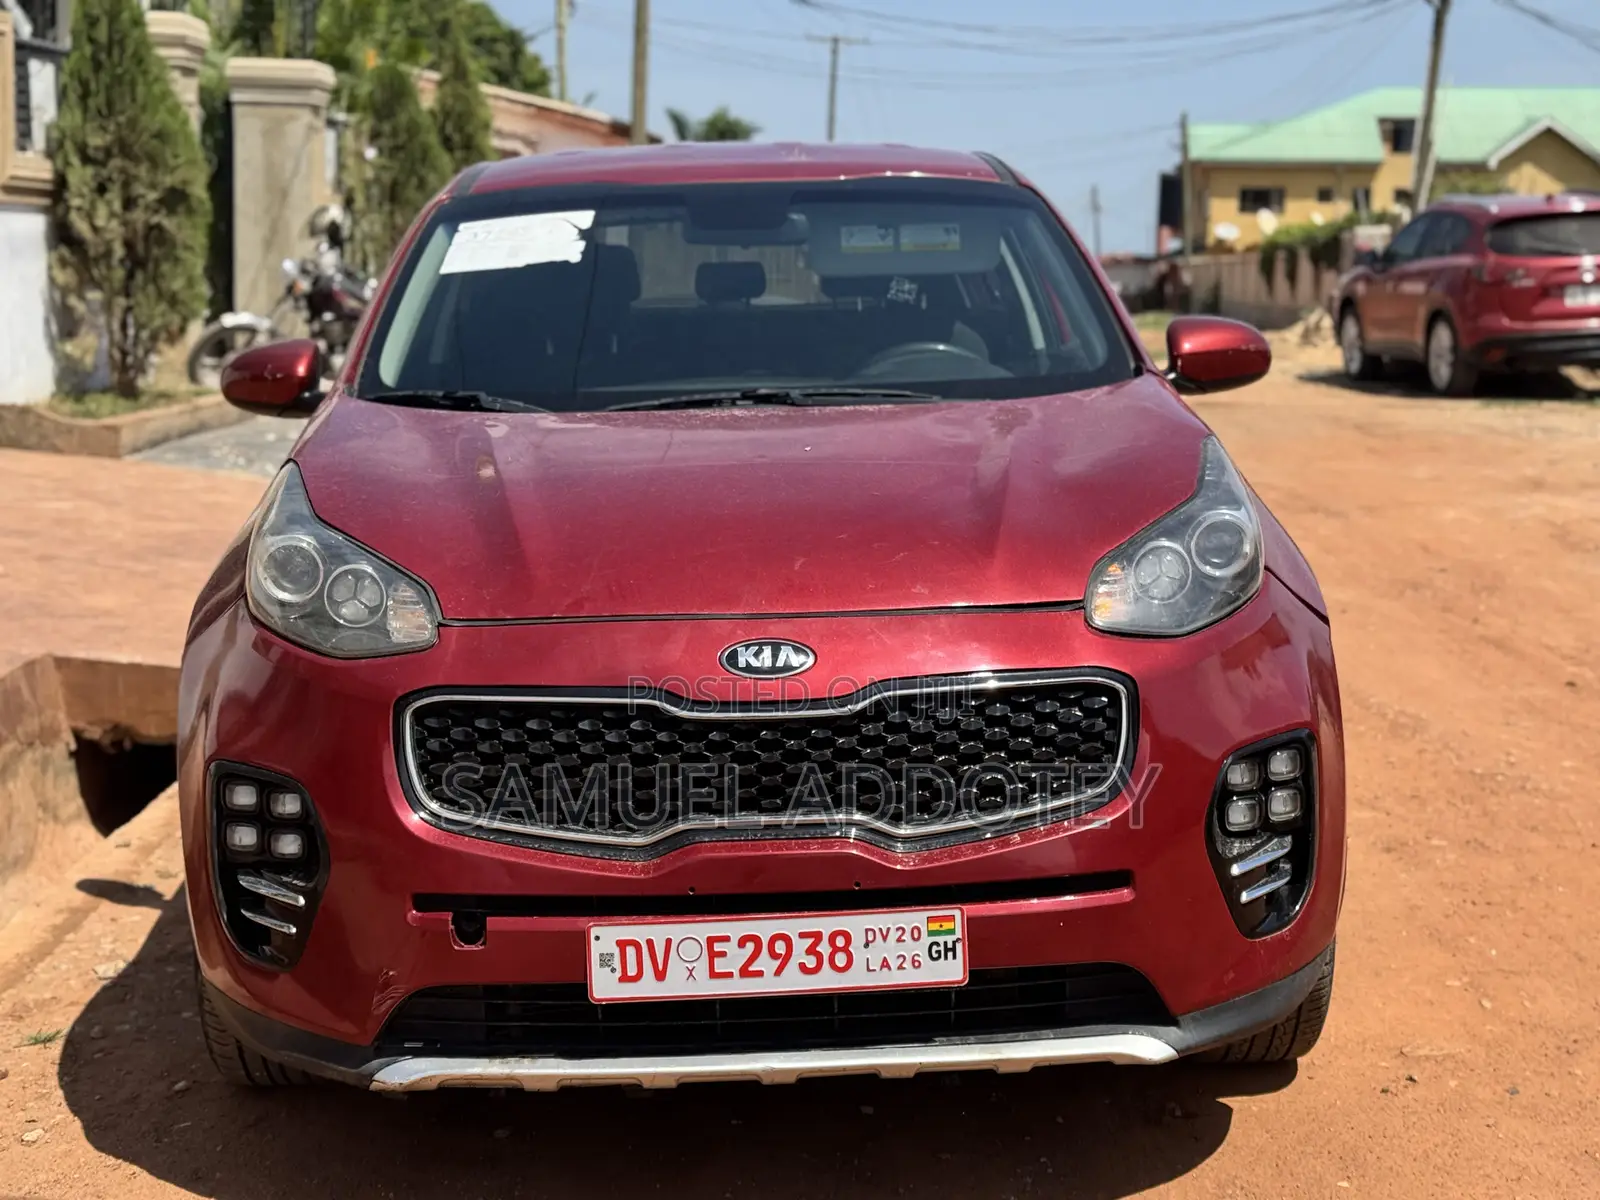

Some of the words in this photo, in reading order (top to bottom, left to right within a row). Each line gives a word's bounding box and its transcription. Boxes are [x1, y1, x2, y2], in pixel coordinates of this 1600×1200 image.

[737, 646, 802, 668] KIA
[864, 924, 923, 945] DV20
[614, 937, 673, 984] DV
[706, 928, 854, 980] E2938
[927, 940, 957, 962] GH
[865, 952, 923, 973] LA26
